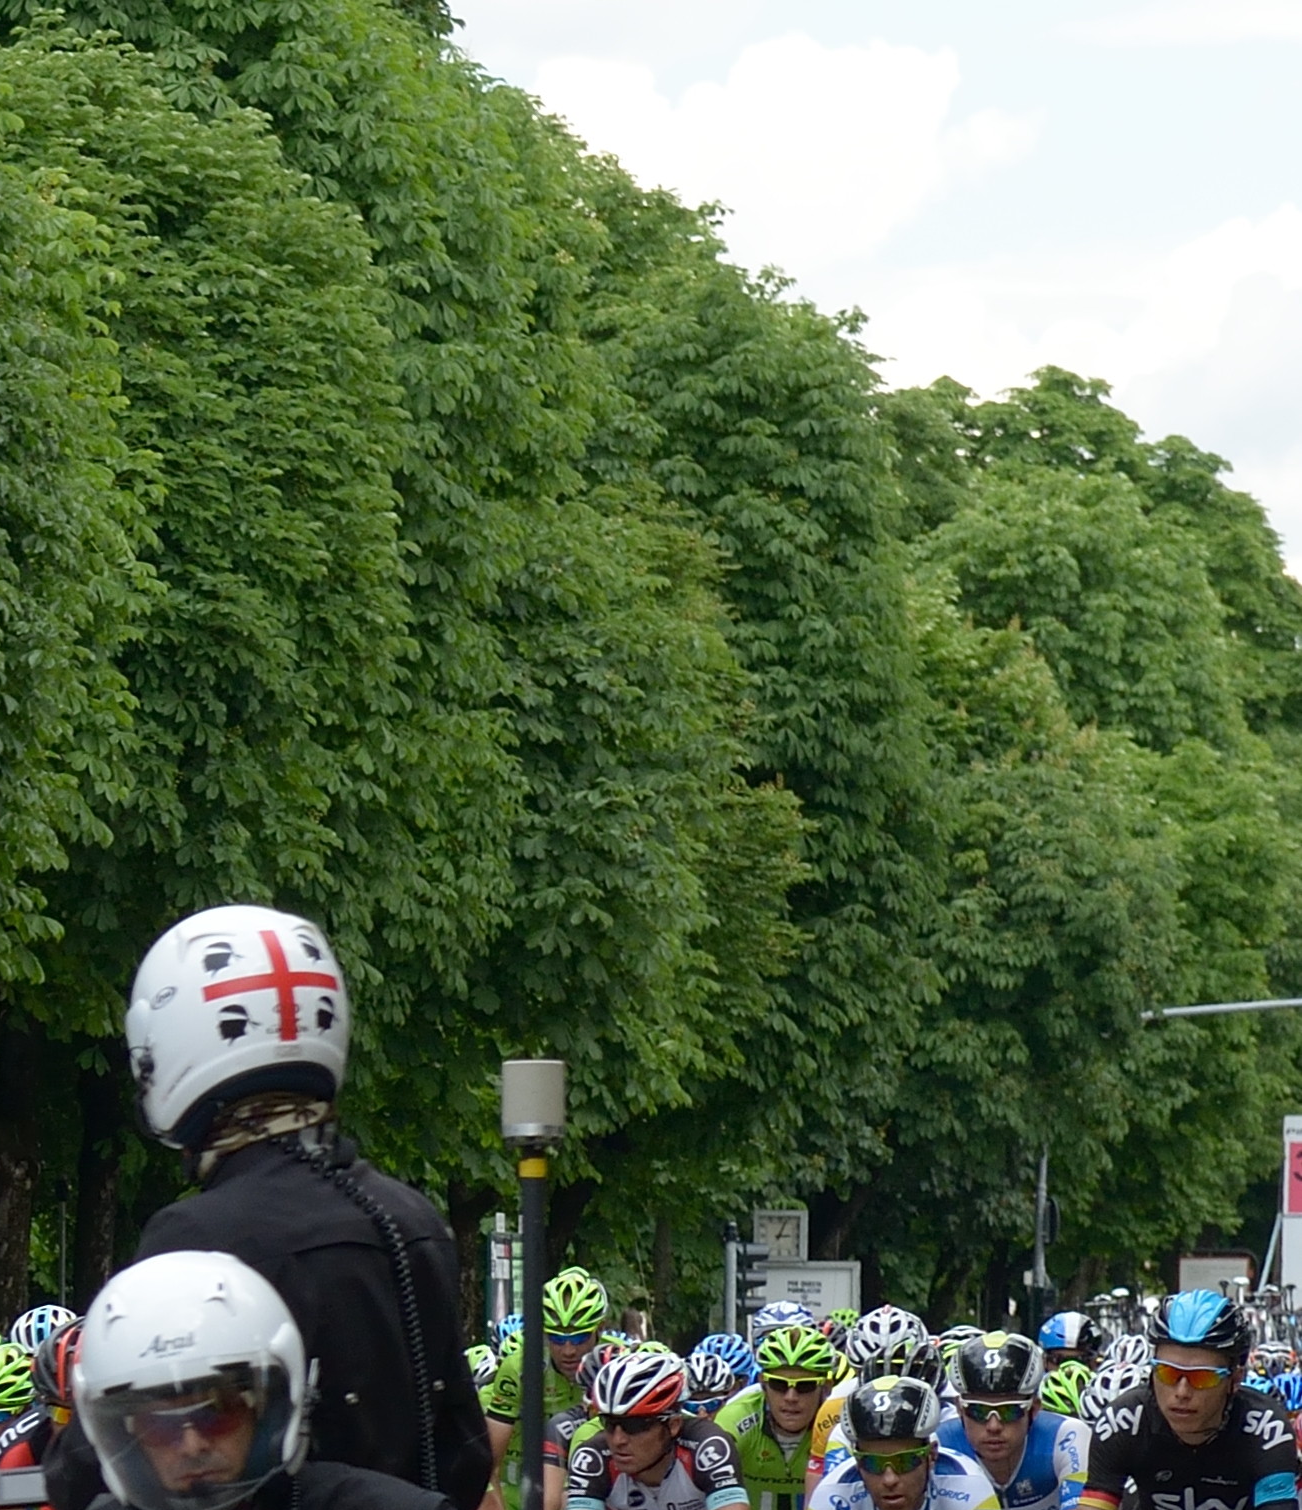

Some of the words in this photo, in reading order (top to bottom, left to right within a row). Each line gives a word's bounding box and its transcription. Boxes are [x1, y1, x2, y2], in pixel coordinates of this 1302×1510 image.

[139, 1332, 195, 1358] Arai
[1096, 1403, 1144, 1442] sky
[1243, 1409, 1294, 1450] sky
[936, 1488, 971, 1502] ORICA
